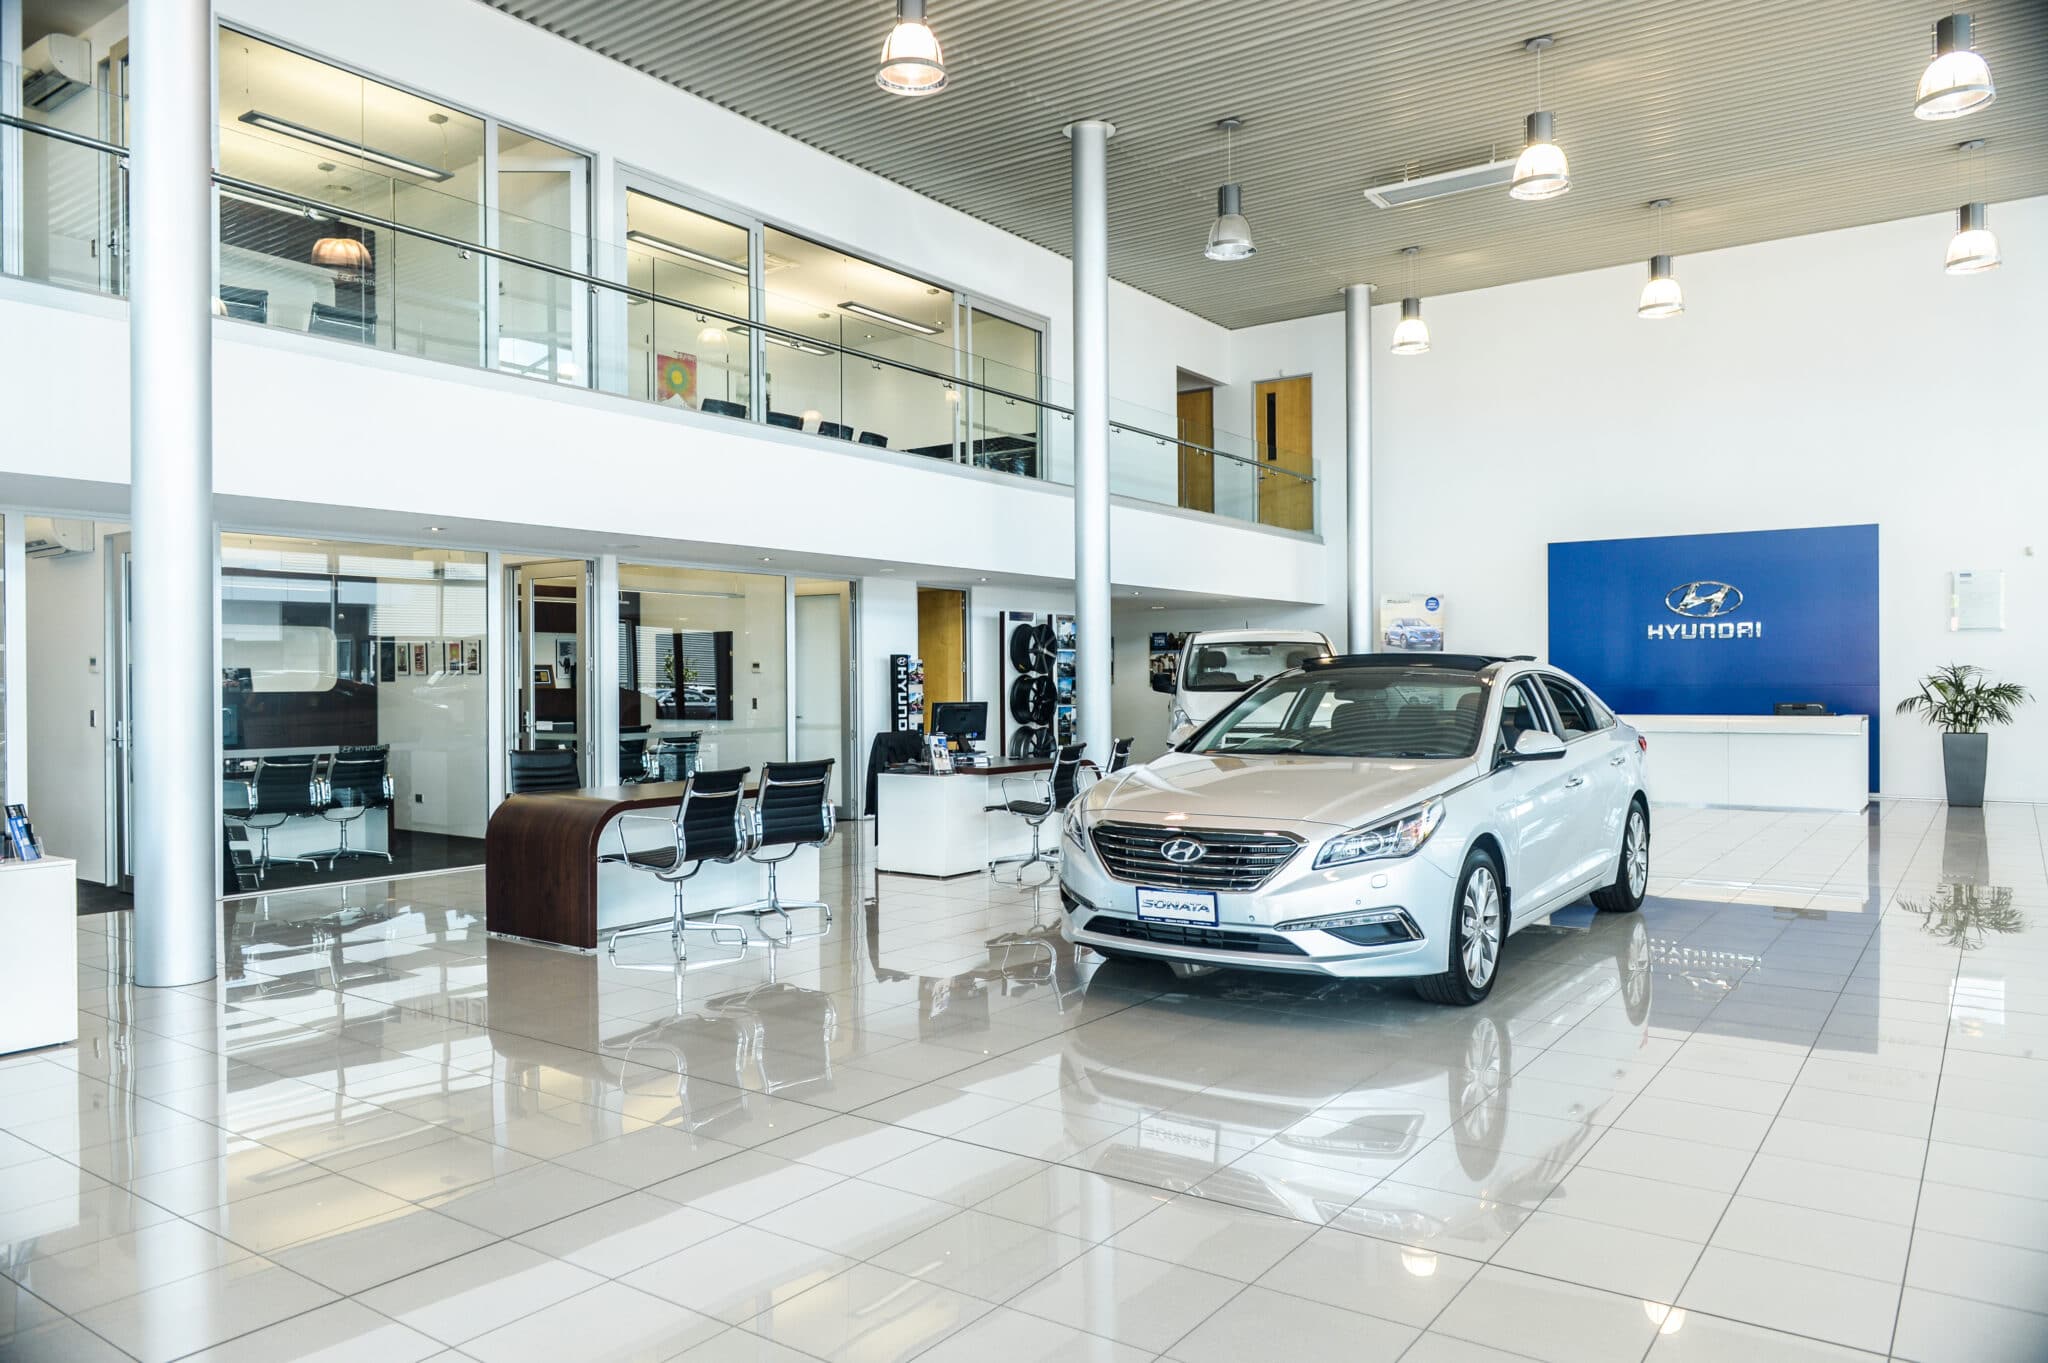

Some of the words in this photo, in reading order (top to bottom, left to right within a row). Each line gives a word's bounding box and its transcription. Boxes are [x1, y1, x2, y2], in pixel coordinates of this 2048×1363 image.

[1647, 621, 1762, 640] HYUNDAI
[897, 666, 908, 731] HYUND
[1142, 899, 1210, 913] SONATA
